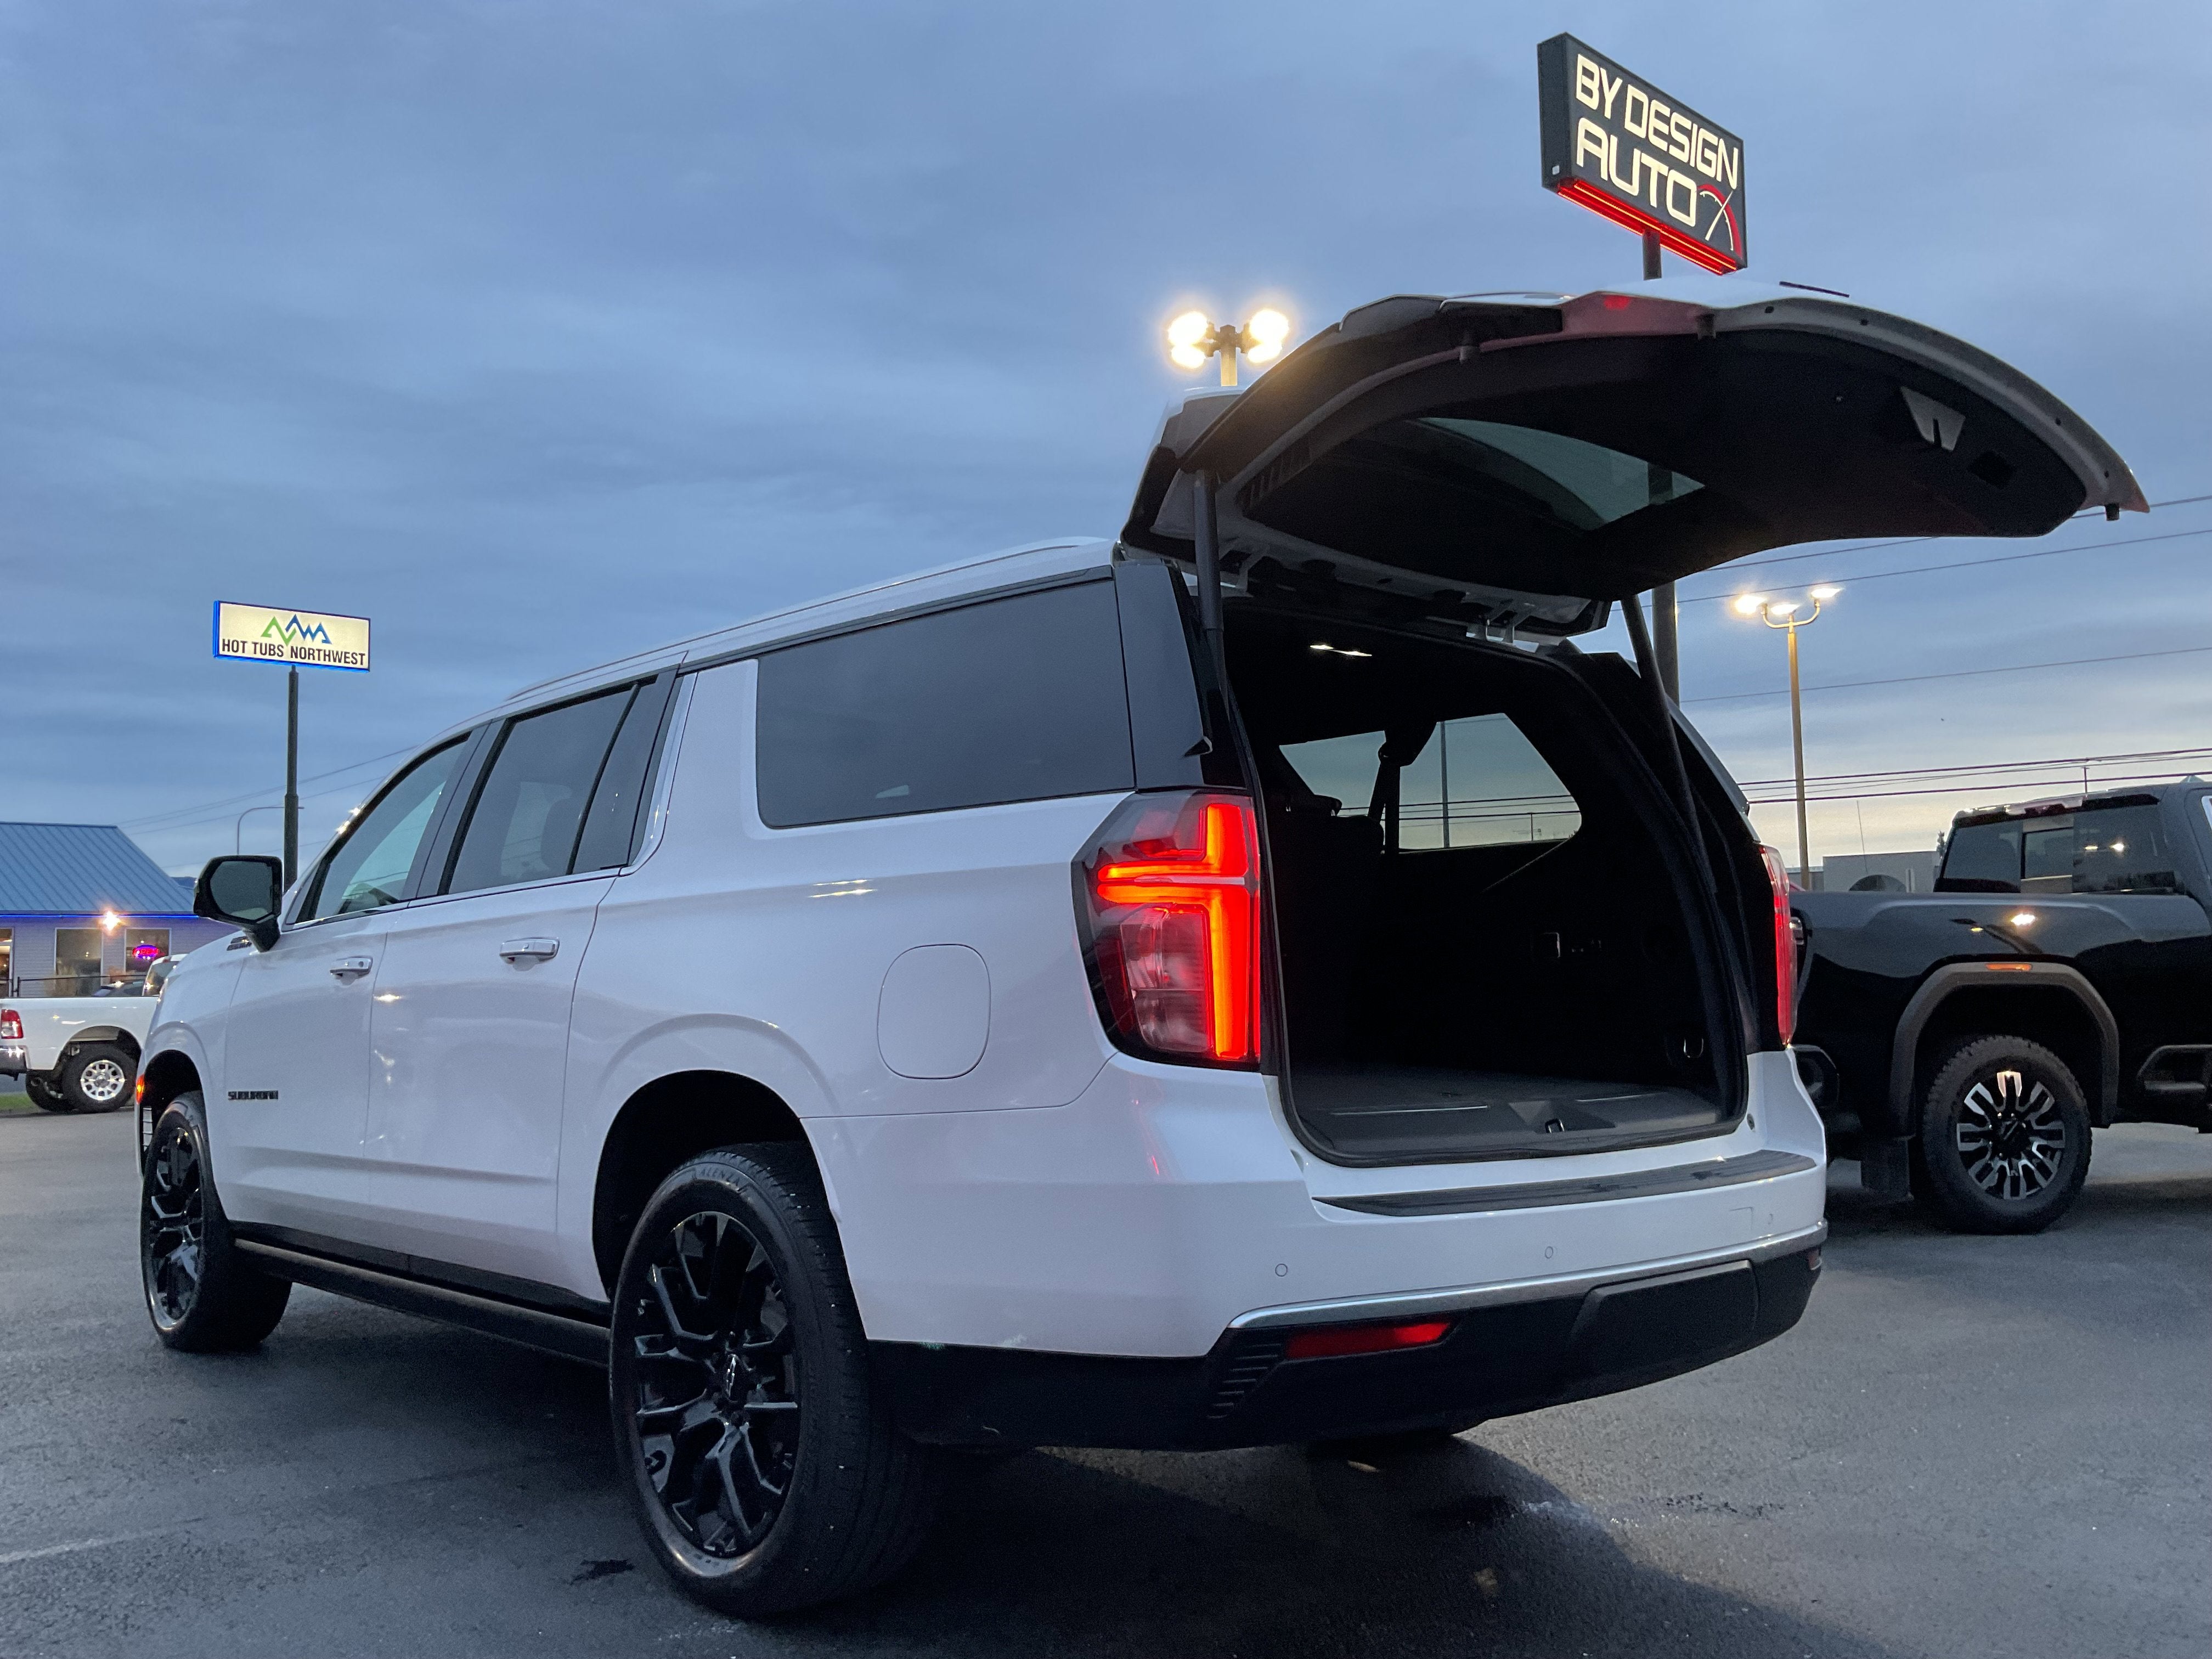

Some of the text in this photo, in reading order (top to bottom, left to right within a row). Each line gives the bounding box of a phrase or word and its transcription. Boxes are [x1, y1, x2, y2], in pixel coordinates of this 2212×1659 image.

[1576, 53, 1739, 189] BY DESIGN
[1576, 117, 1697, 227] AUTO
[222, 639, 366, 666] HOT TUBS NORTHWEST
